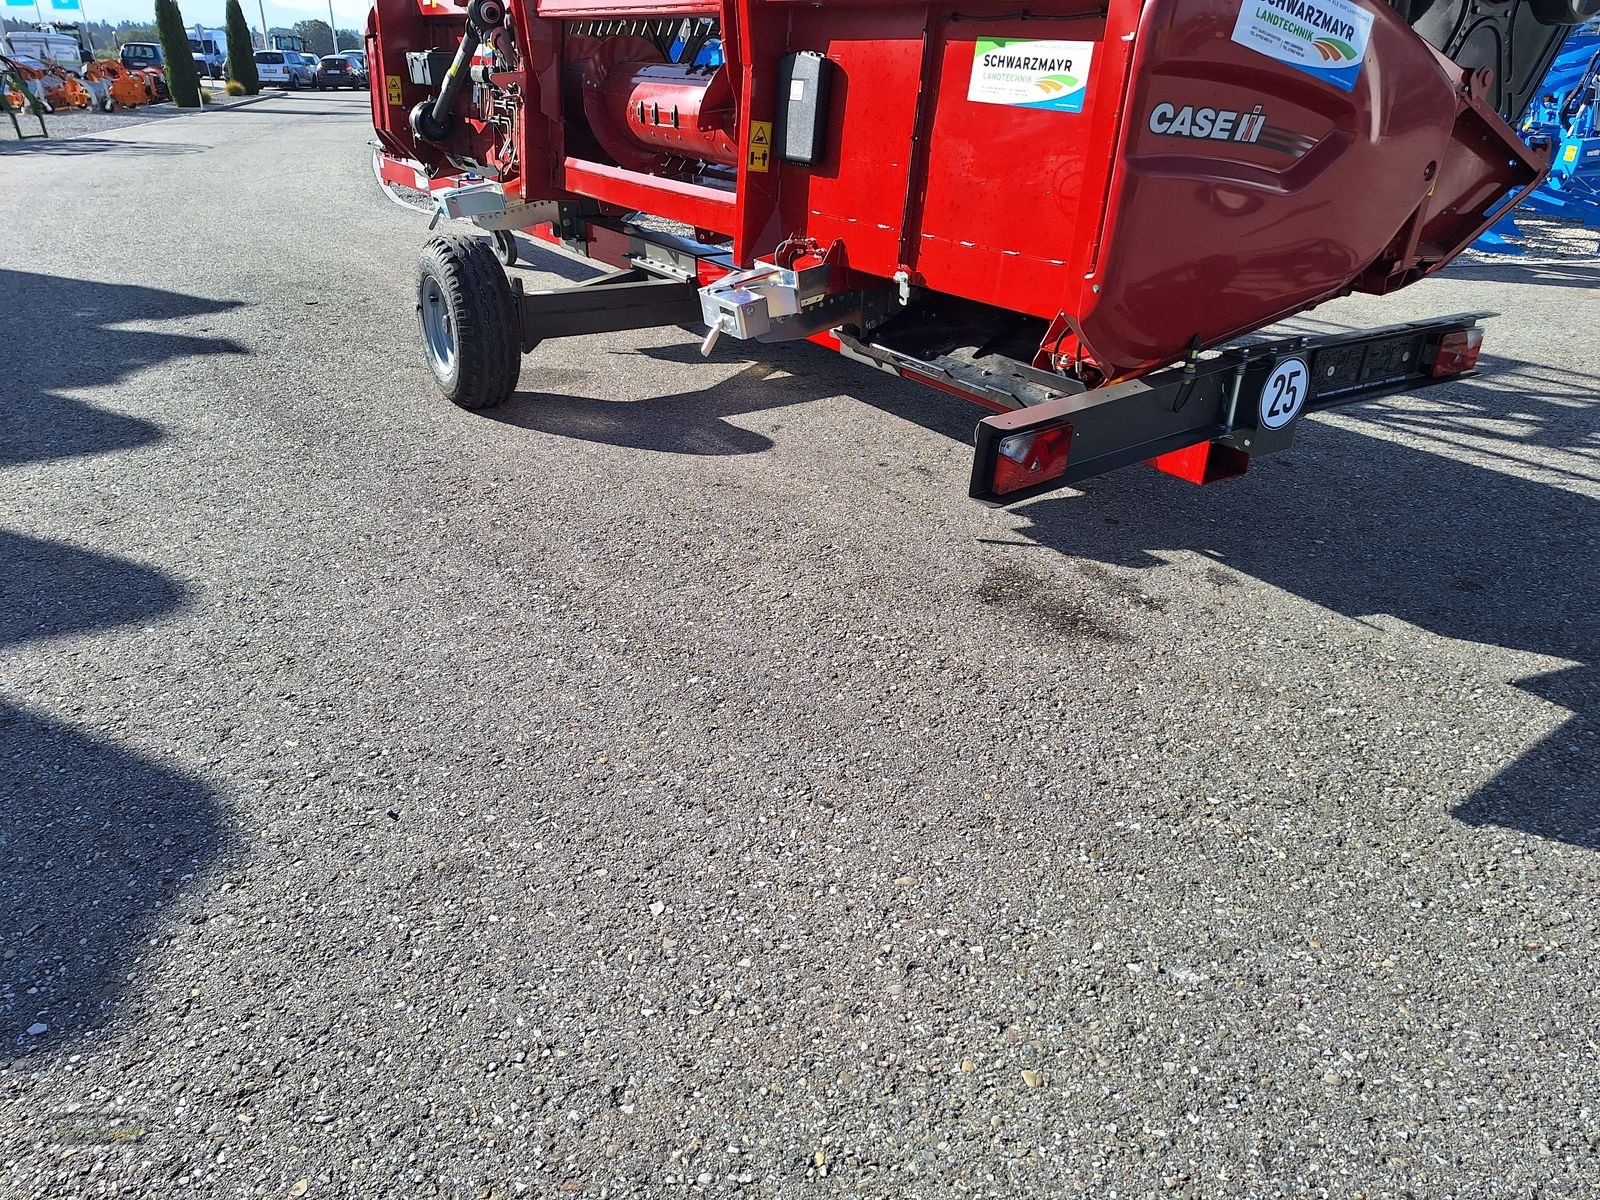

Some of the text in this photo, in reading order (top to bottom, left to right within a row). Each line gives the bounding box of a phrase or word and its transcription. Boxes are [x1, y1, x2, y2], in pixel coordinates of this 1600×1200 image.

[1255, 6, 1315, 42] LANDTECHNIK
[1261, 0, 1355, 42] HWARZMAYR
[982, 72, 1033, 84] LANDTECHNIK
[983, 54, 1073, 72] SCHWARZMAYR
[1149, 102, 1237, 140] CASE
[1267, 369, 1302, 418] 25
